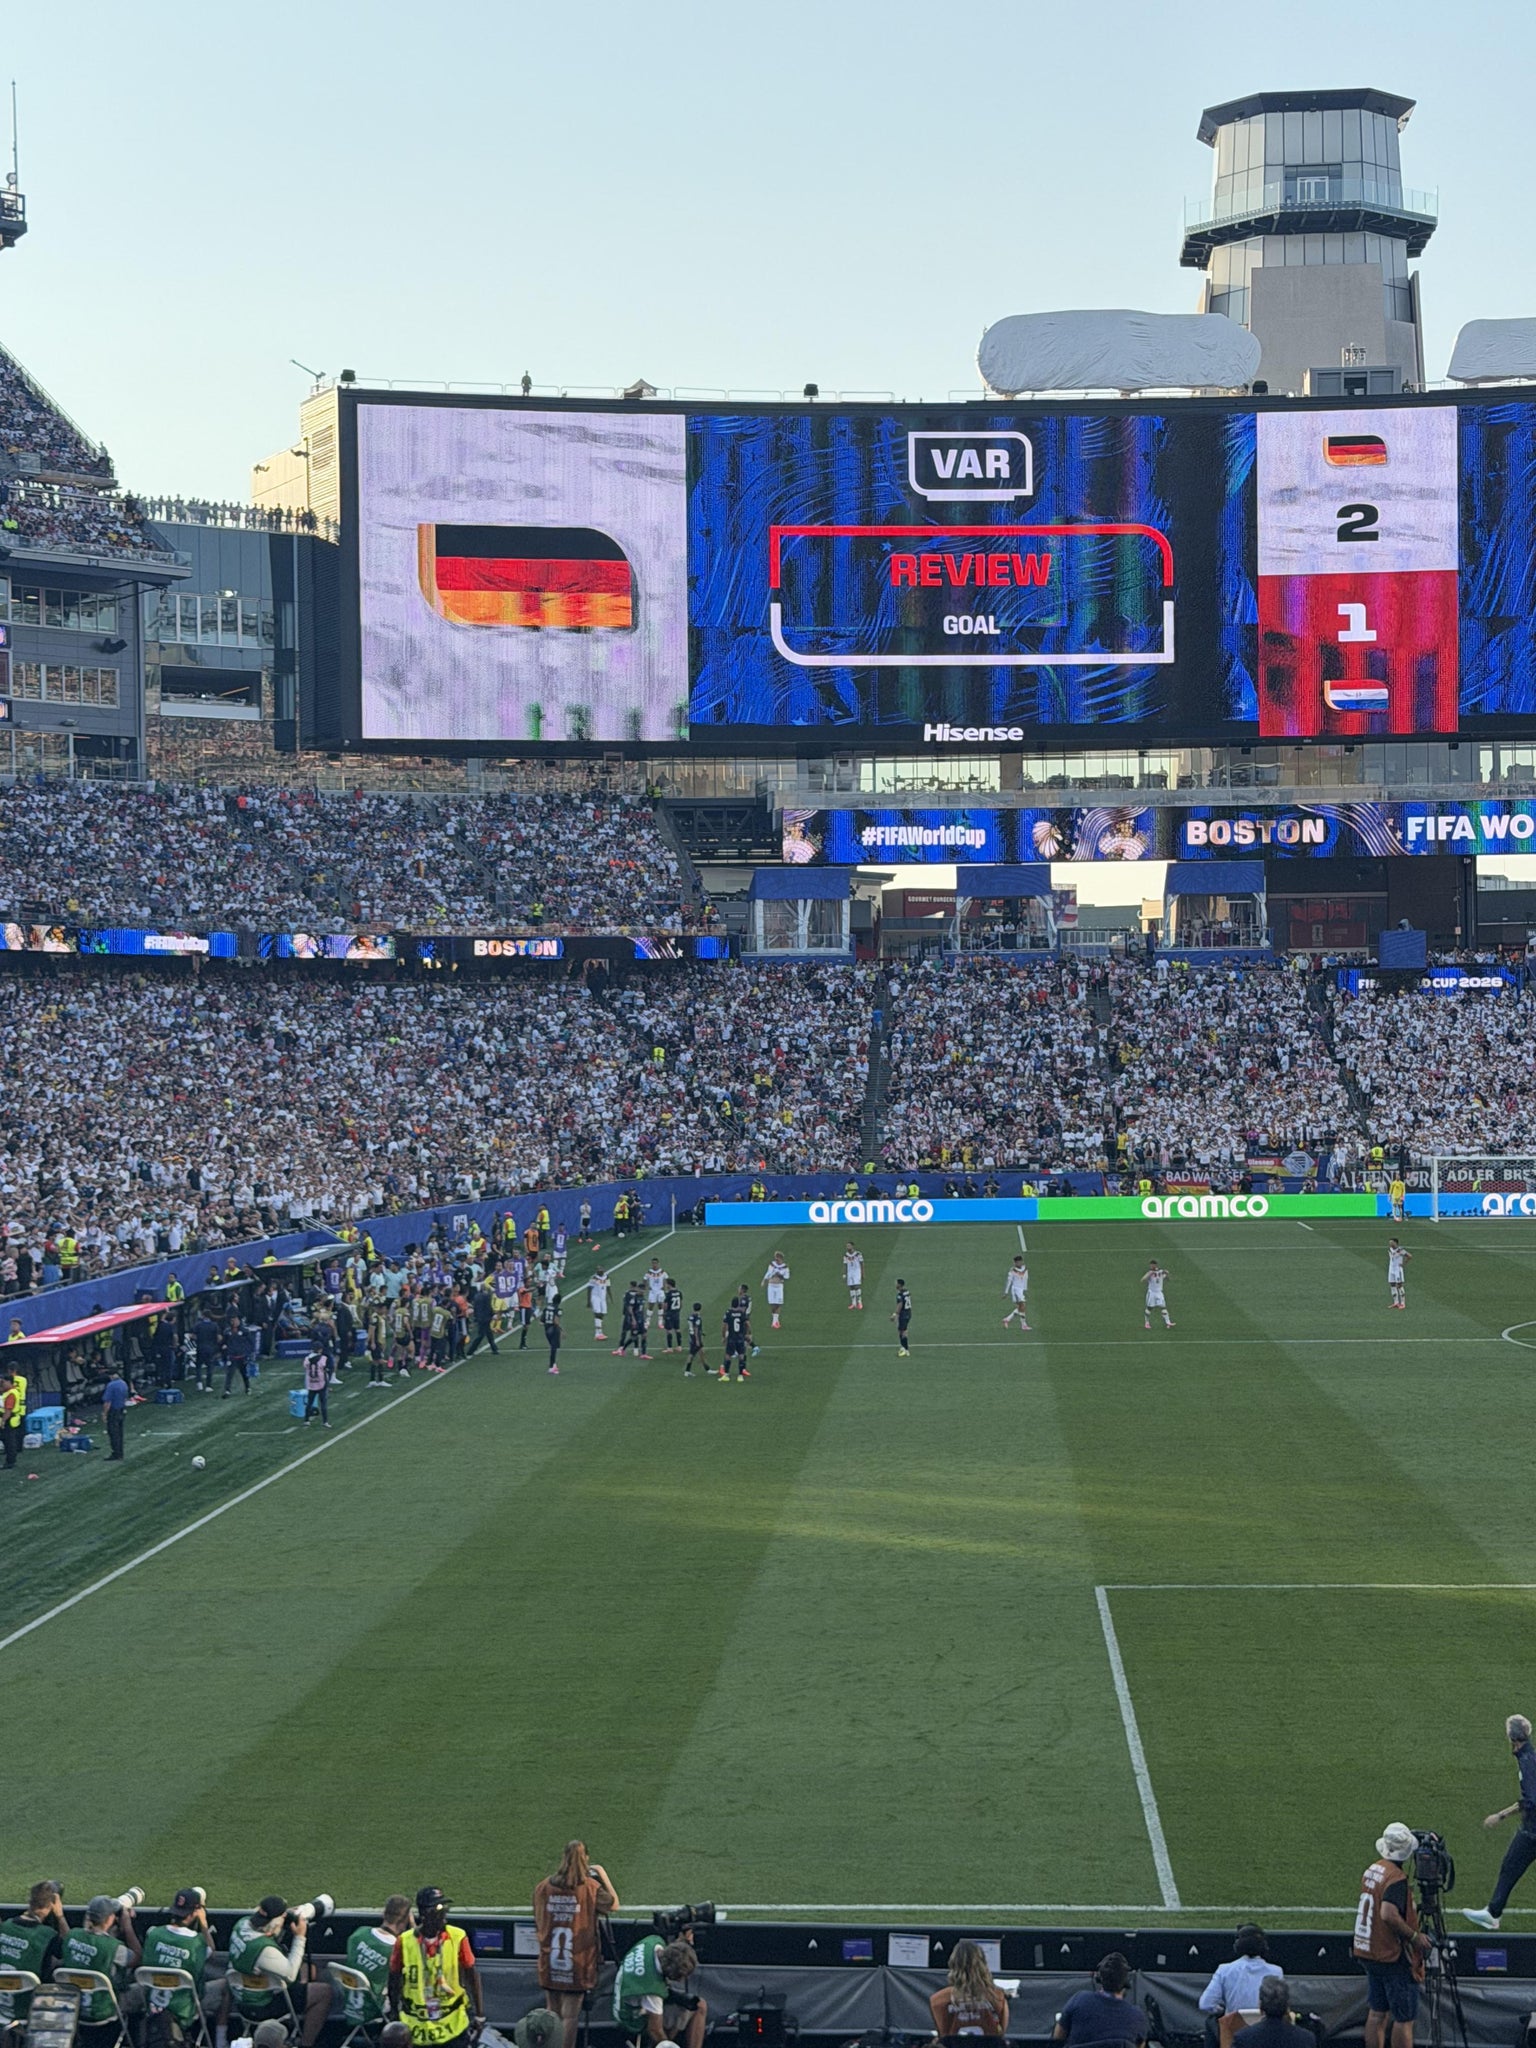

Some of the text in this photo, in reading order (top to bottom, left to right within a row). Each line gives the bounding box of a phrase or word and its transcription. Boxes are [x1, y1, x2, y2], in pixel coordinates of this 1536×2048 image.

[930, 449, 1010, 478] VAR
[1336, 503, 1379, 542] 2
[890, 553, 1052, 586] REVIEW
[943, 615, 1001, 635] GOAL
[1337, 602, 1377, 642] 1
[923, 723, 1024, 742] Hisense
[861, 824, 986, 848] #FIFAWorldCup
[1186, 818, 1325, 845] BOSTON
[1407, 813, 1535, 841] FIFA WO
[473, 938, 558, 957] BOSTON
[1432, 977, 1457, 988] CUP
[1458, 976, 1503, 988] 2026
[1166, 1170, 1190, 1182] BAD
[1340, 1170, 1442, 1188] ALTENURG
[1446, 1168, 1495, 1181] ADLER
[808, 1199, 935, 1224] aramco
[1140, 1194, 1270, 1219] aramco
[356, 1940, 388, 1966] PHOTO
